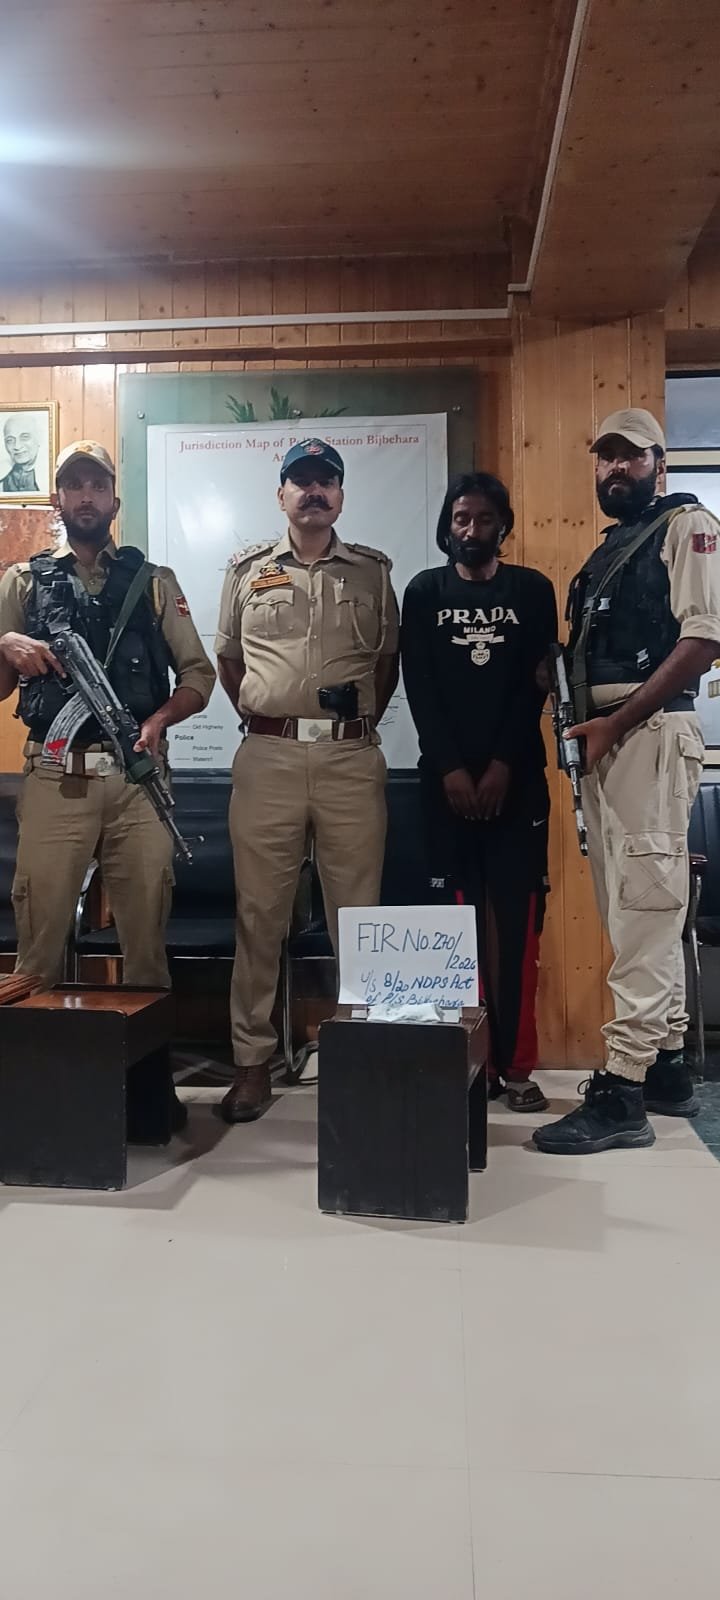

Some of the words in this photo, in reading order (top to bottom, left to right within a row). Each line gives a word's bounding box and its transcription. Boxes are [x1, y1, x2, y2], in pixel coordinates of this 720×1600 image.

[179, 440, 242, 453] Jurisdiction
[245, 438, 270, 451] Map
[273, 438, 284, 447] of
[325, 436, 363, 446] Station
[367, 434, 419, 448] Bijbehara
[437, 606, 520, 626] PRADA
[463, 625, 496, 634] MILANO
[358, 923, 399, 952] FIR
[383, 970, 410, 993] 8/20
[410, 975, 449, 990] NDPS
[449, 973, 474, 990] Act
